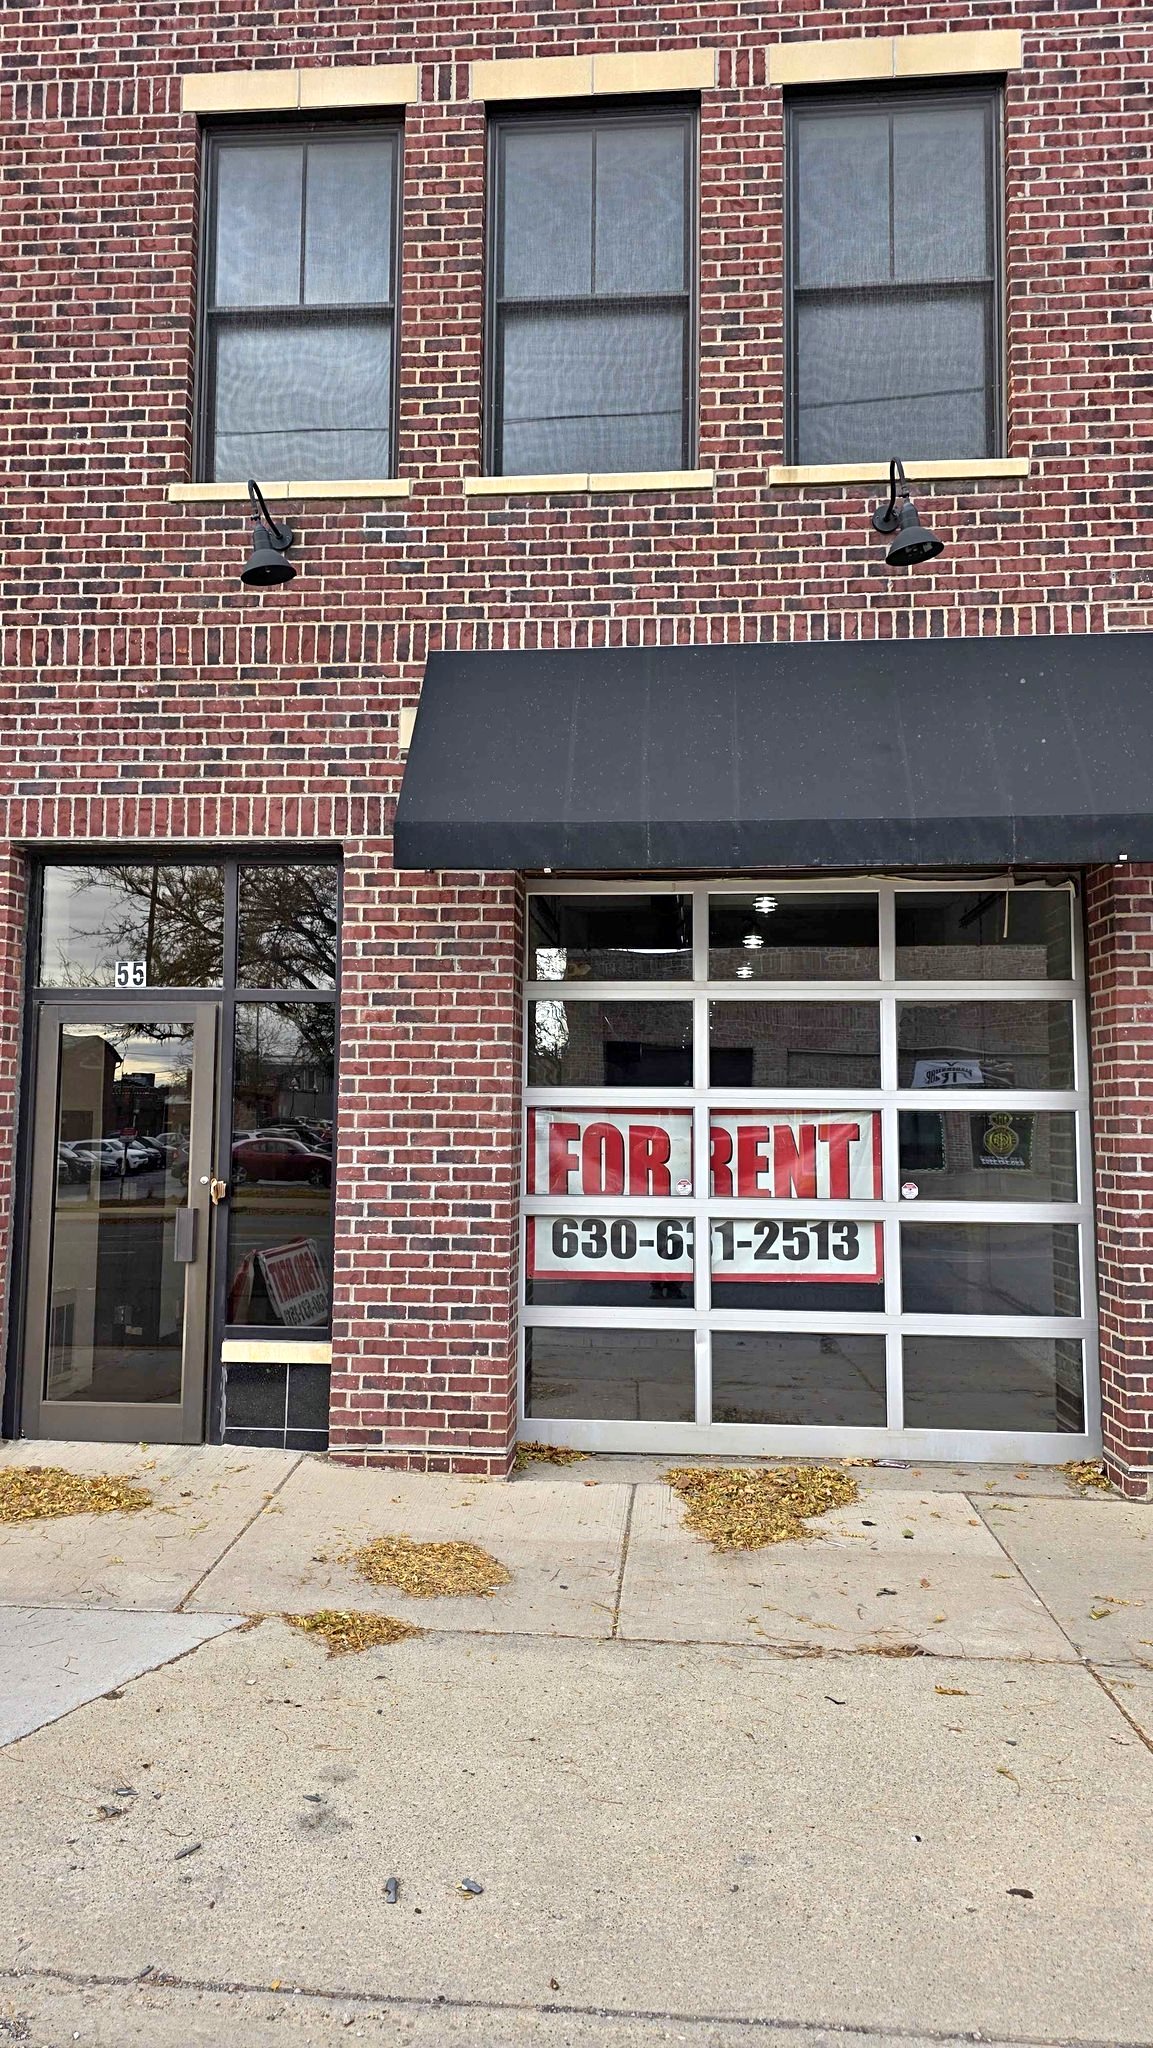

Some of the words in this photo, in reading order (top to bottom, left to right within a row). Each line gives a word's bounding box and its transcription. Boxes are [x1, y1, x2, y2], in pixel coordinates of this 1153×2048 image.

[117, 962, 144, 986] 55
[549, 1122, 671, 1195] FOR
[691, 1123, 860, 1198] RENT
